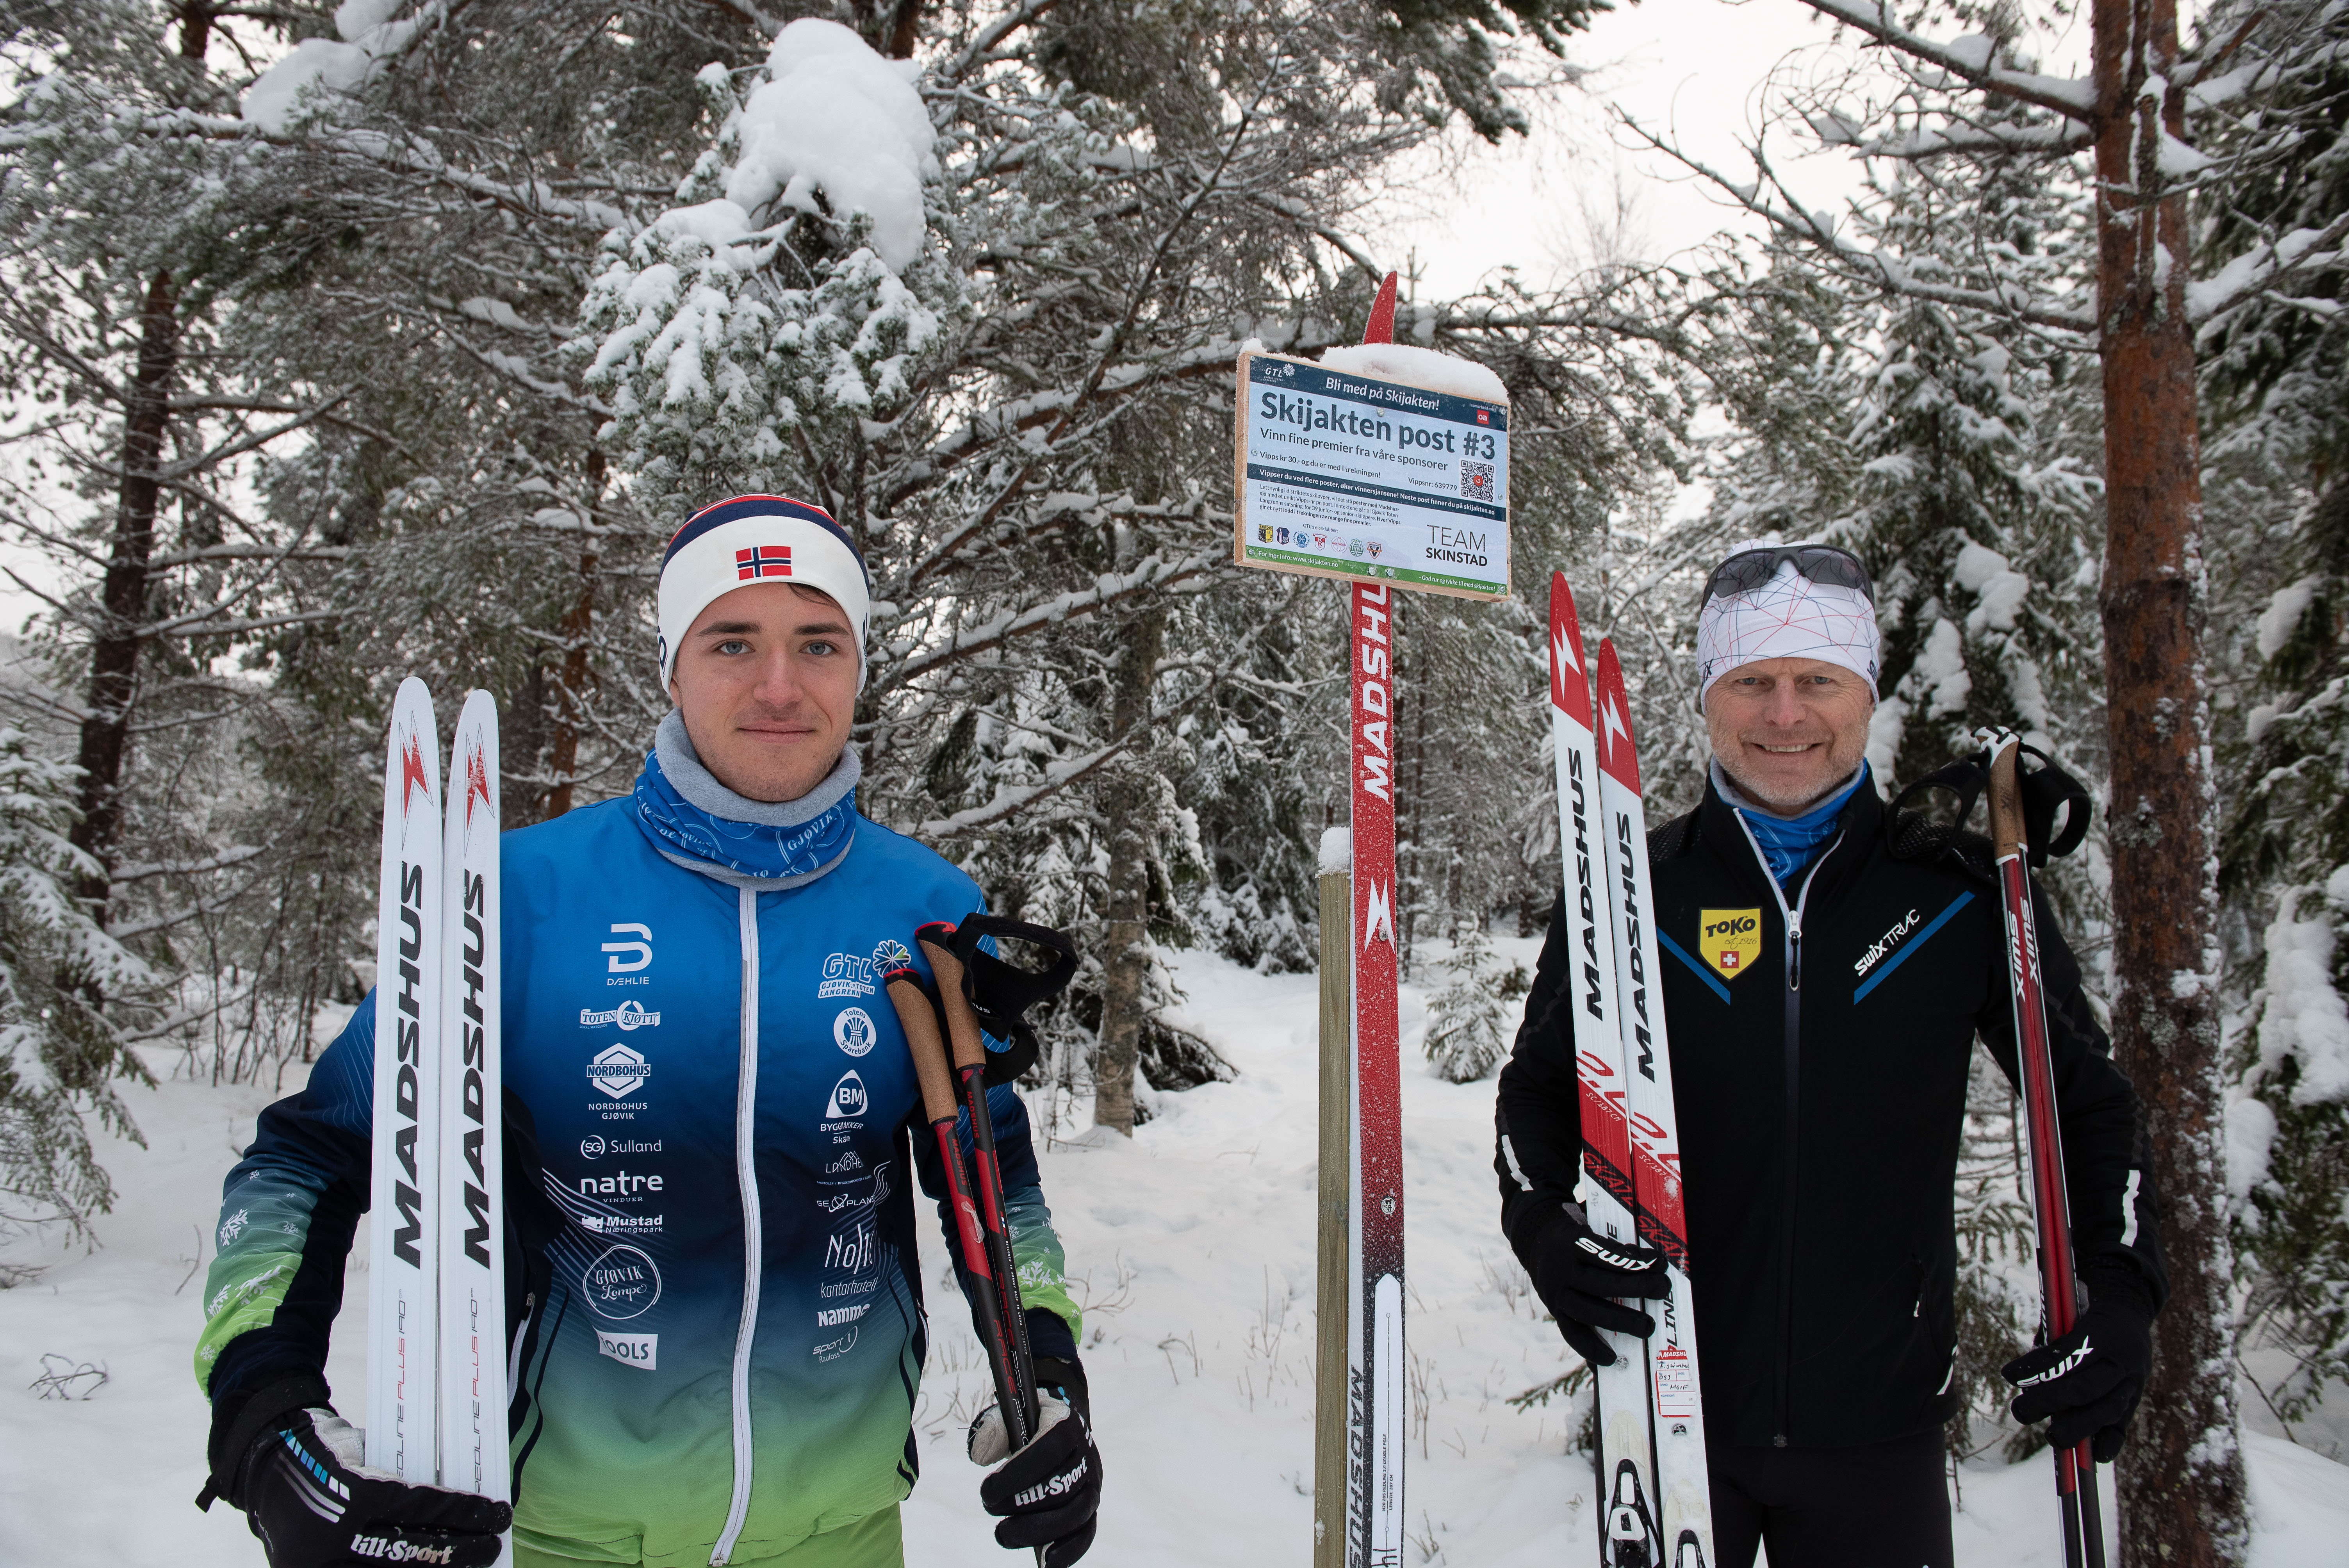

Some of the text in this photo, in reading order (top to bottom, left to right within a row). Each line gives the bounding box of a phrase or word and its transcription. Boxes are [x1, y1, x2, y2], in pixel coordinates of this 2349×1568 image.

[1265, 367, 1283, 377] GTL
[1326, 377, 1439, 410] Bli med på Skijakten!
[1260, 392, 1495, 460] Skijakten post #3
[1260, 427, 1448, 470] Vinn fine premier fra våre sponsorer
[1260, 451, 1278, 460] Vipps
[1345, 467, 1380, 478] trekningen!
[1259, 469, 1283, 478] Vippser
[1320, 480, 1339, 488] poster,
[1355, 485, 1398, 498] vinnersjansene!
[1400, 493, 1416, 501] Neste
[1463, 504, 1494, 515] skijakten.no
[1408, 477, 1457, 491] Vippsnr: 639779
[1310, 492, 1331, 501] skiløyper,
[1334, 502, 1358, 511] Inntektene
[1260, 497, 1283, 505] Langrenns
[1340, 511, 1376, 520] senior-skiløpere.
[1427, 524, 1485, 552] TEAM
[1292, 556, 1338, 567] www.skijakten.no
[1426, 547, 1487, 566] SKINSTAD
[1361, 586, 1389, 804] MADSHU
[1568, 747, 1603, 1022] MADSHUS
[1706, 916, 1756, 937] TOKO
[1883, 909, 1920, 945] TRIAC
[1616, 811, 1656, 1083] MADSHUS
[822, 953, 872, 983] GTL
[607, 976, 649, 986] DÆHLIE
[856, 984, 874, 994] TOTEN
[820, 989, 860, 997] LANGRENN
[583, 1012, 655, 1023] TOTEN KJØTT
[844, 1009, 866, 1019] Totens
[840, 1039, 872, 1055] Sparebank
[394, 861, 422, 1270] MADSHUS
[463, 869, 490, 1270] MADSHUS
[587, 1064, 650, 1077] NORDBOHUS
[588, 1102, 647, 1111] NORDBOHUS
[838, 1087, 863, 1105] BM
[967, 1091, 980, 1139] MADSHUS
[820, 1121, 864, 1131] BYGGMAKKER
[585, 1139, 662, 1154] SG Sulland
[951, 1139, 967, 1186] MADSHUS
[581, 1171, 663, 1196] natre
[607, 1215, 663, 1226] Mustad
[596, 1265, 644, 1286] GJØVIK
[601, 1283, 647, 1302] Lompe
[821, 1277, 878, 1298] kontorhotell
[817, 1304, 870, 1327] Nammo
[997, 1272, 1015, 1347] RACE
[601, 1336, 649, 1361] TOOLS
[813, 1336, 844, 1355] sport
[819, 1352, 840, 1363] Raufoss
[994, 1320, 1016, 1394] RACE
